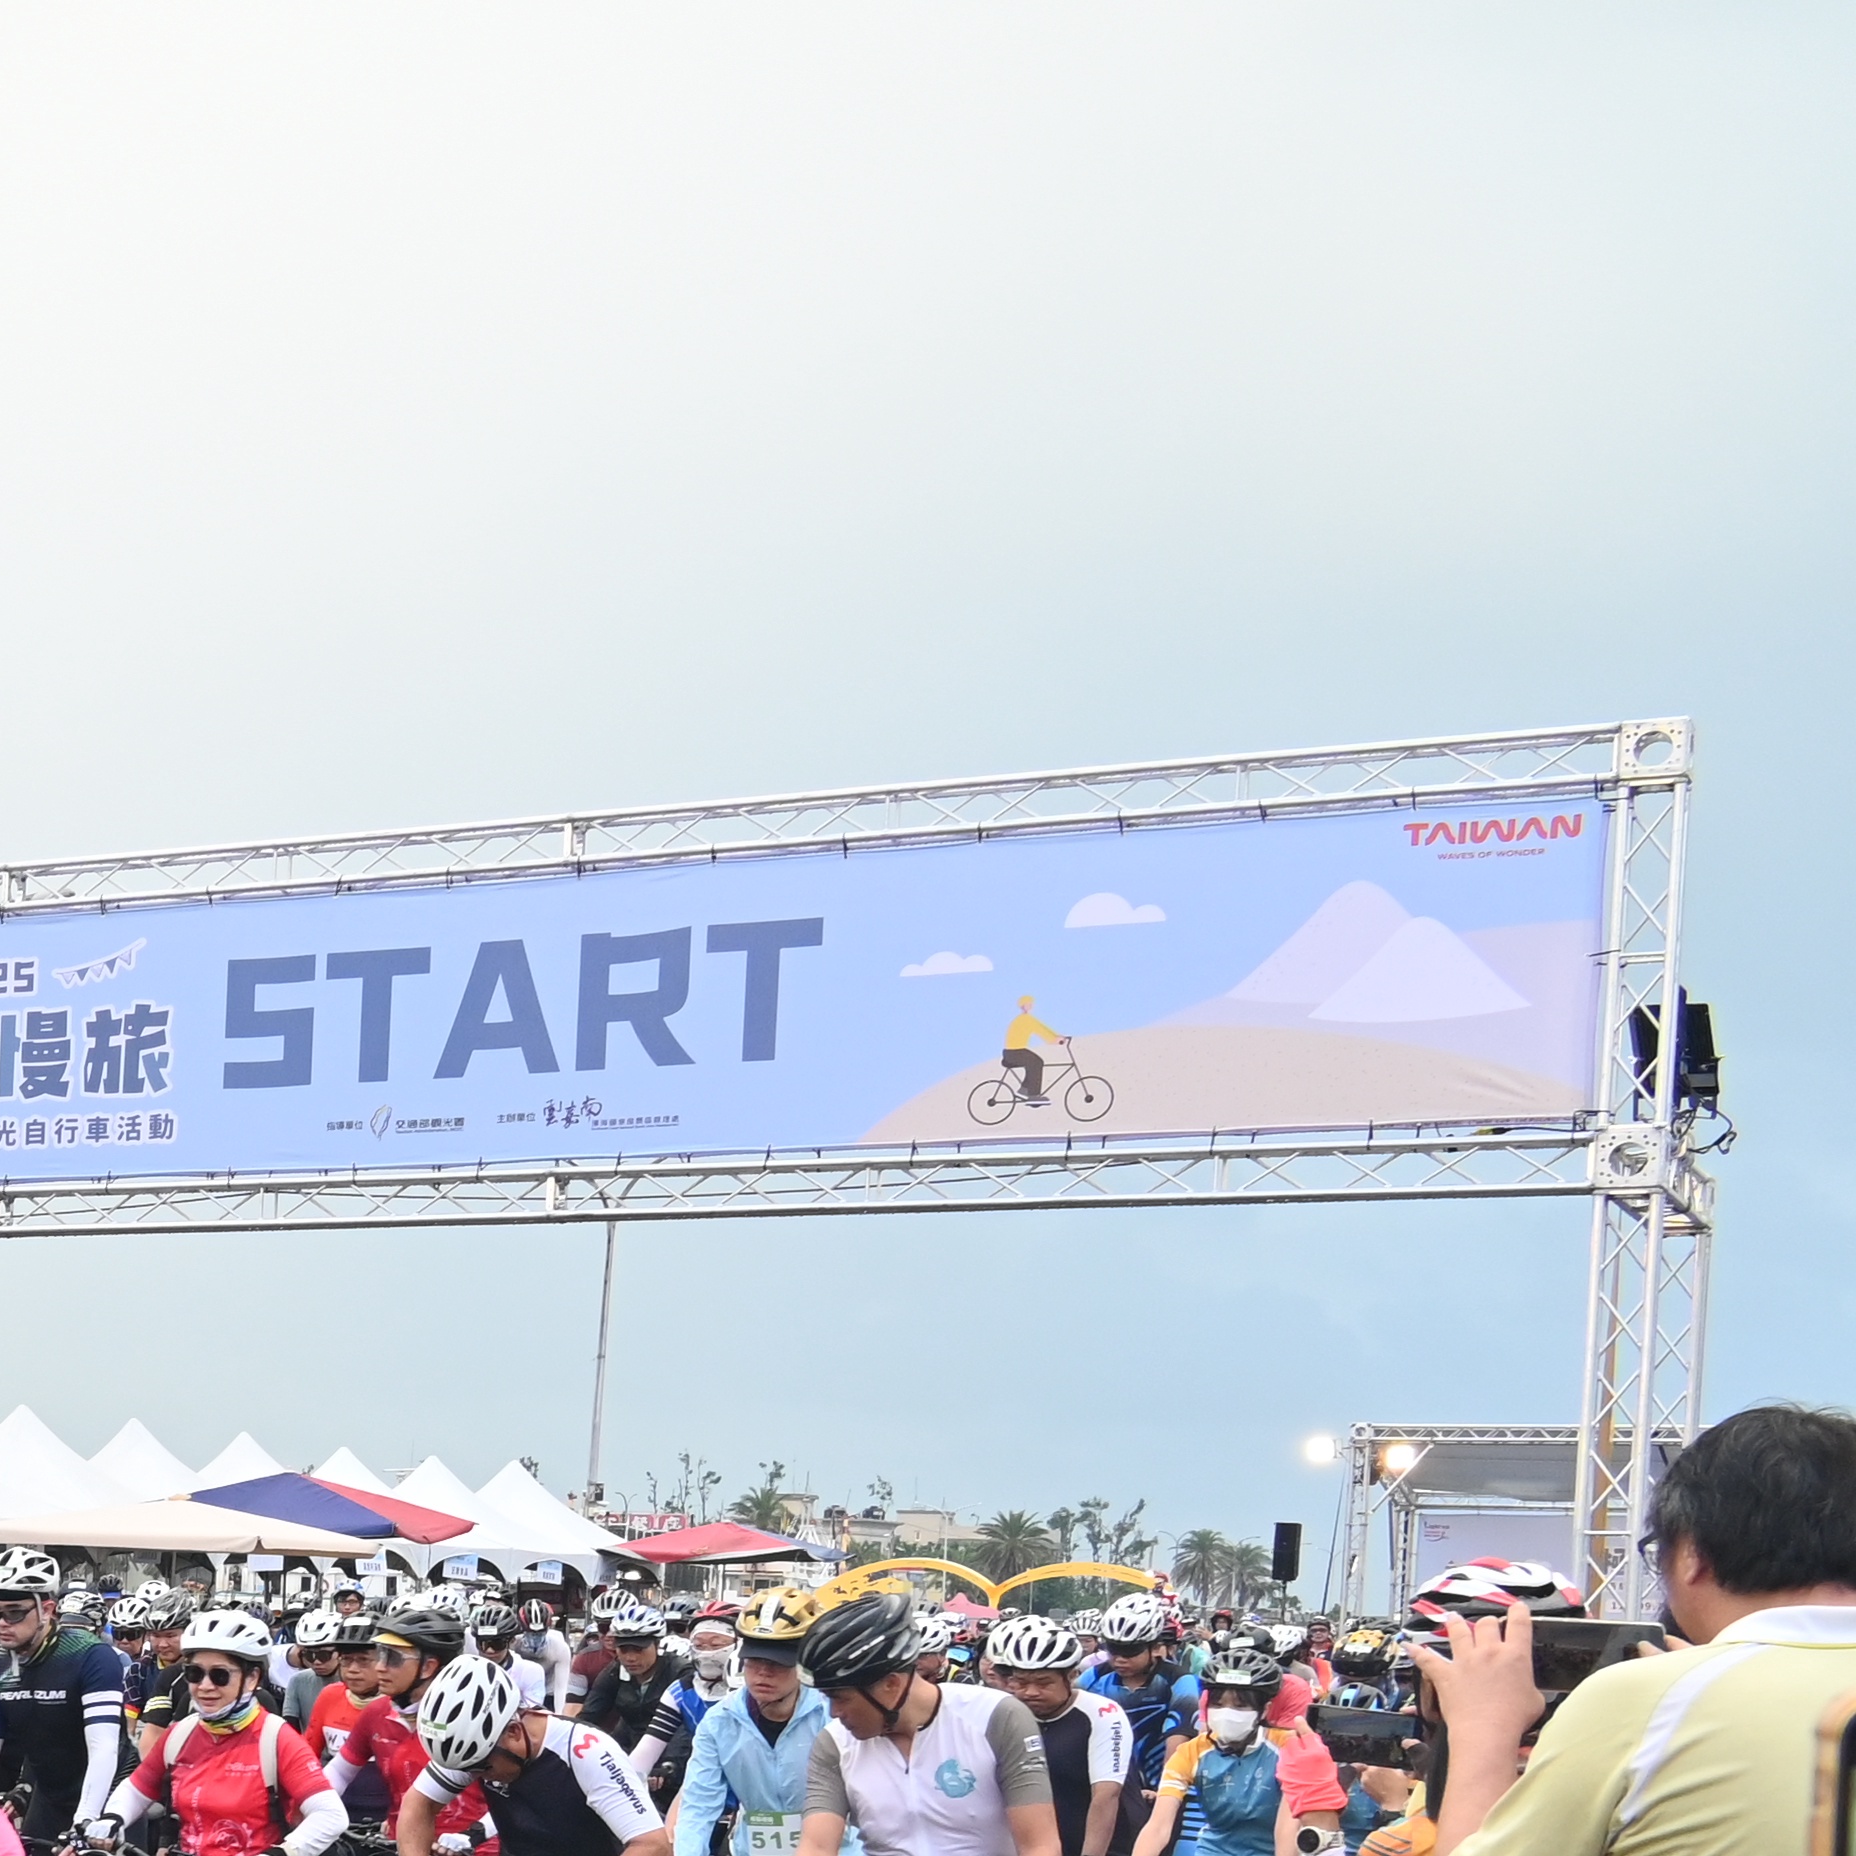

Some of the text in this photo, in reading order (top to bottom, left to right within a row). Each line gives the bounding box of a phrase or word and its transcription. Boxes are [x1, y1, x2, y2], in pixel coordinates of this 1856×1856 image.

[1403, 814, 1583, 846] TAIWAN
[1437, 848, 1545, 860] WAVES OF WONDER
[221, 917, 825, 1091] START
[752, 1830, 802, 1850] 515
